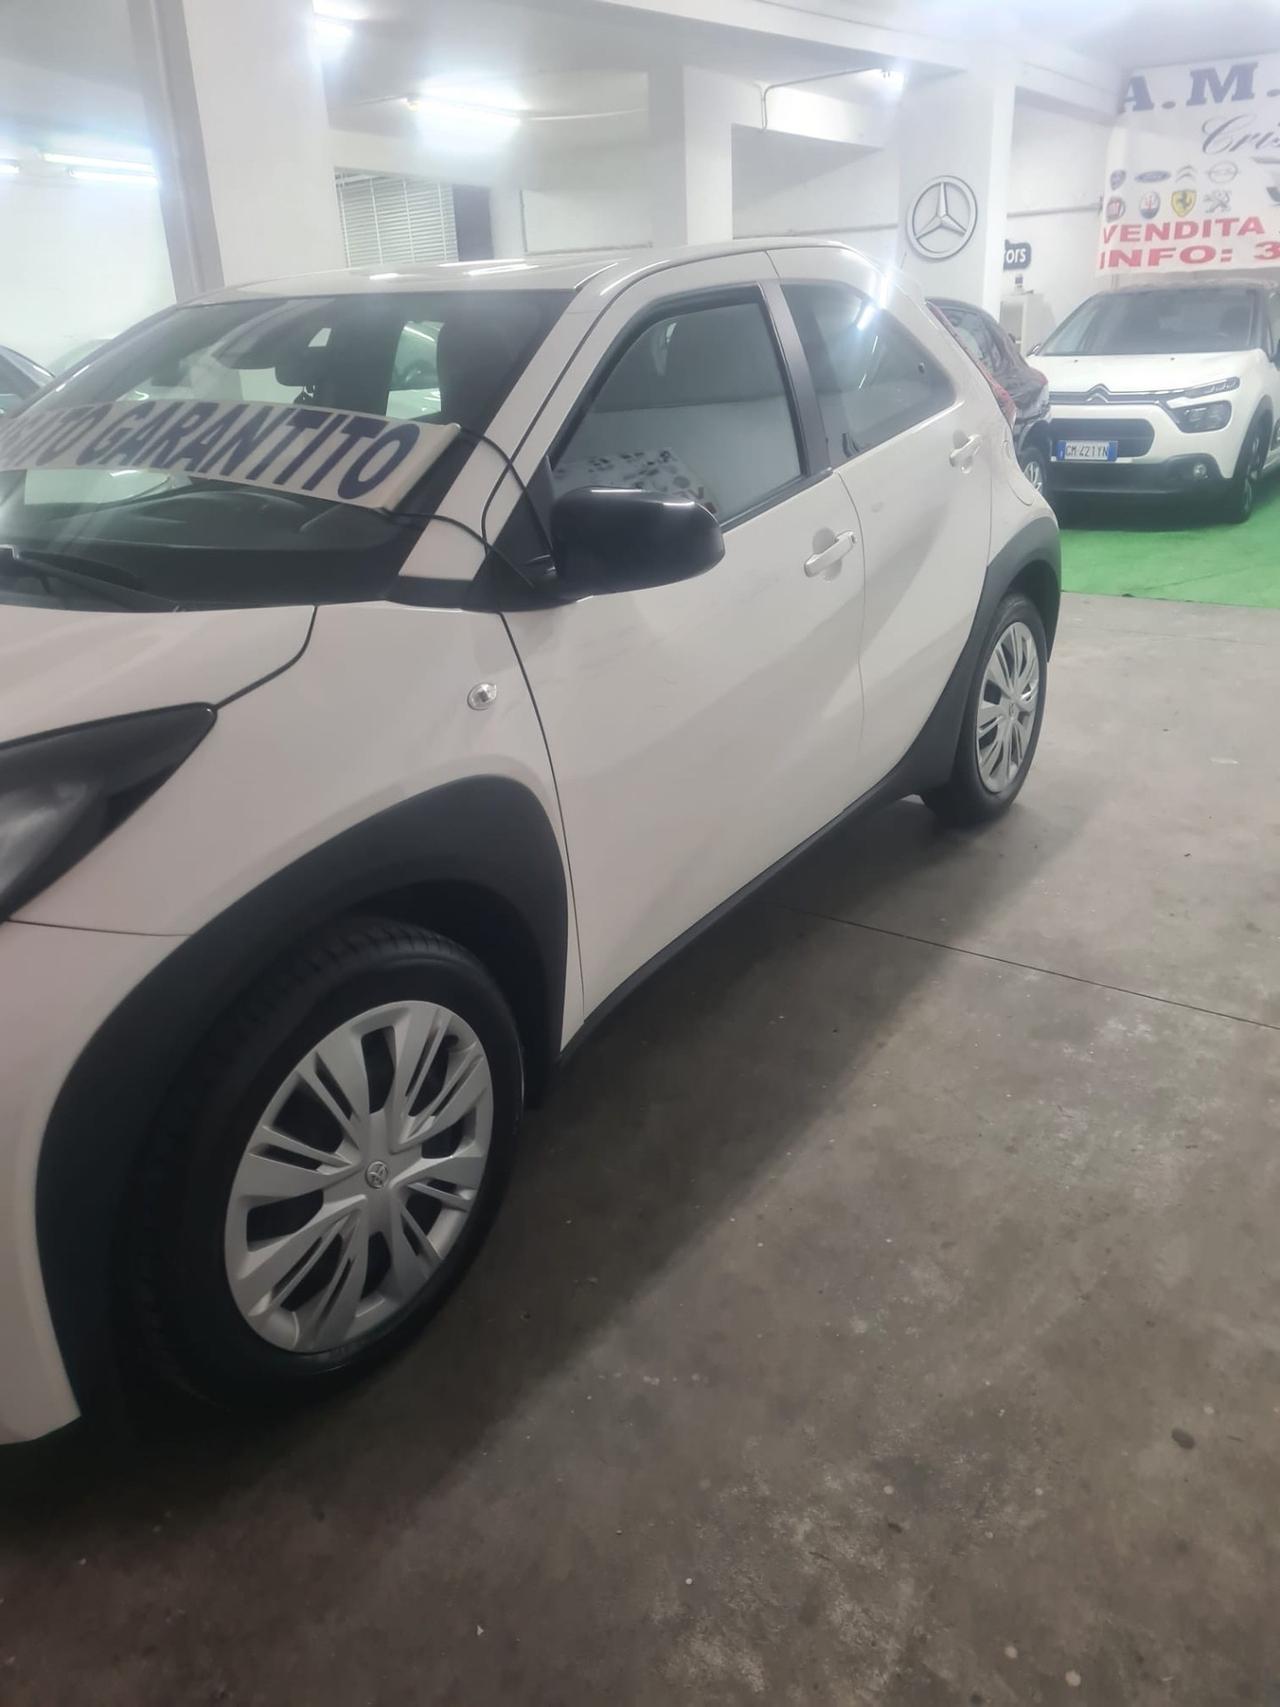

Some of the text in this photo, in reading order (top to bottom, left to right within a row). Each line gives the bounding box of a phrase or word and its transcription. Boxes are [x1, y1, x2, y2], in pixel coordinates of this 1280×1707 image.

[1103, 216, 1265, 244] VENDITA
[1100, 245, 1234, 270] INFO:
[75, 400, 420, 499] GARANTITO
